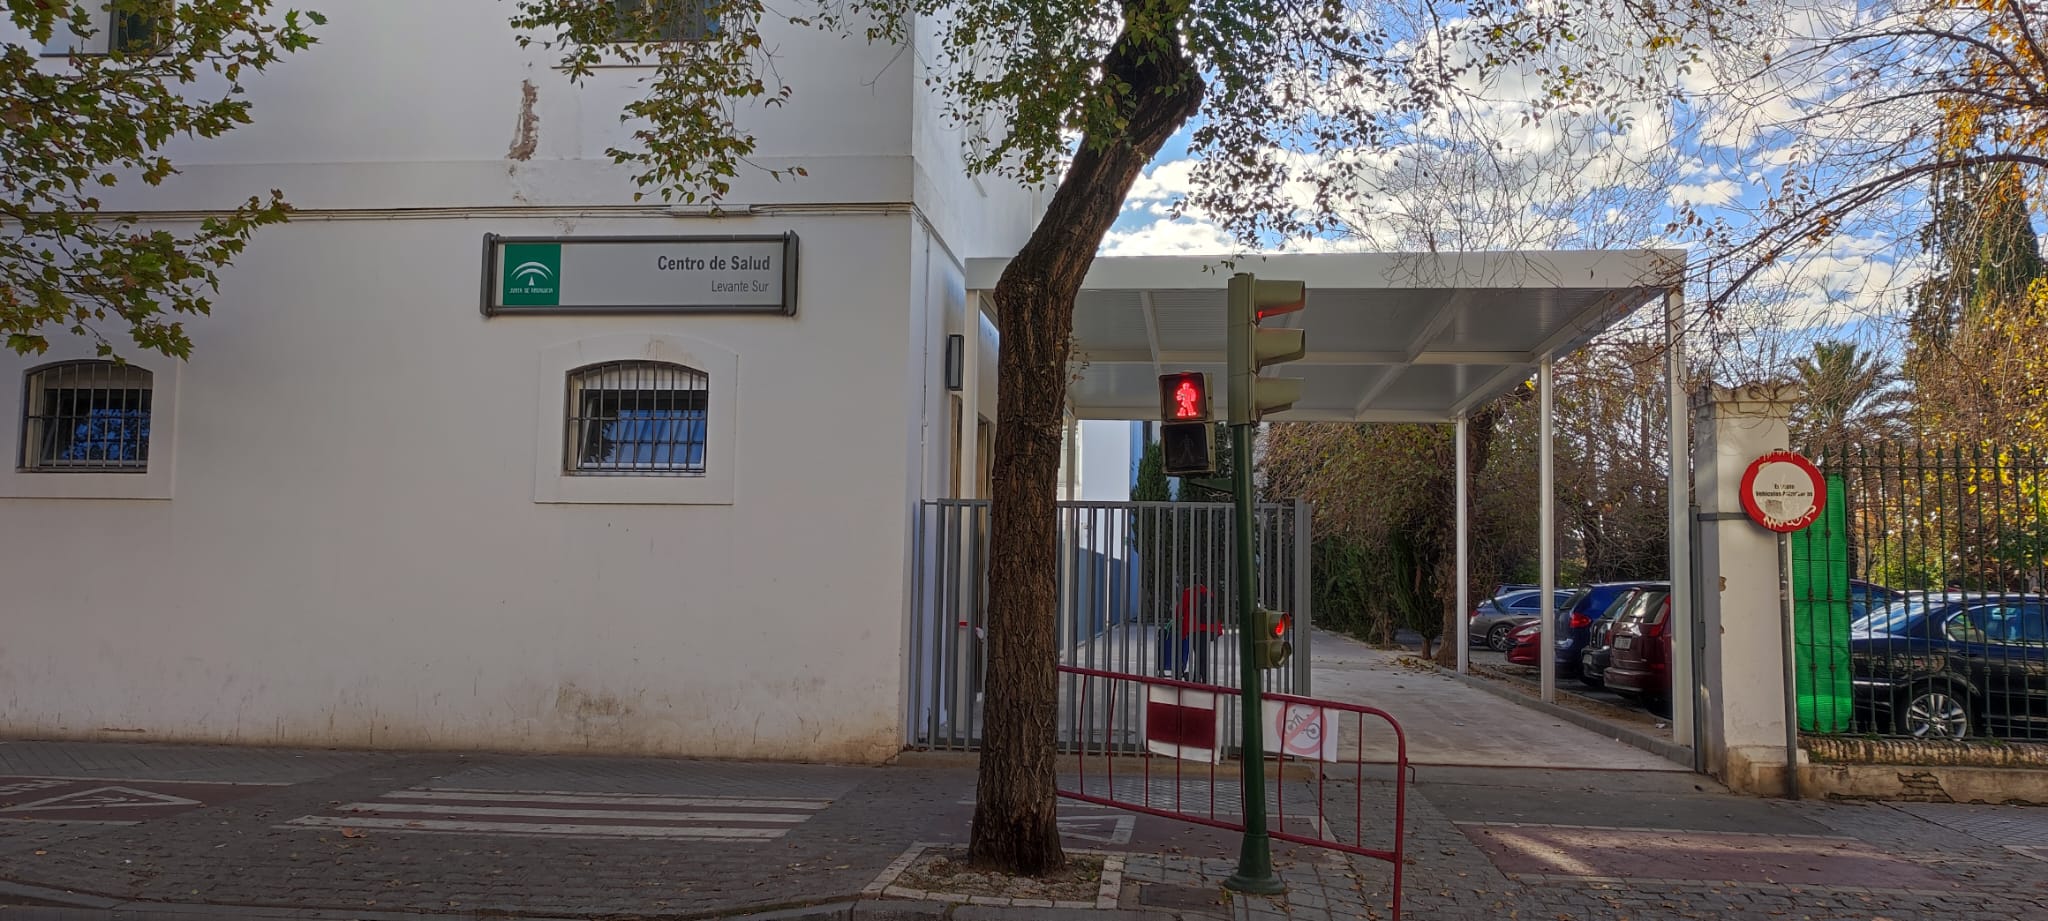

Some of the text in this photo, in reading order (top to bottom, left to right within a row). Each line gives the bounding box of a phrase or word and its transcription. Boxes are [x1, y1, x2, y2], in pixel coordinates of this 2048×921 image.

[658, 255, 771, 271] Centro de Salud
[711, 280, 769, 293] Levante Sur
